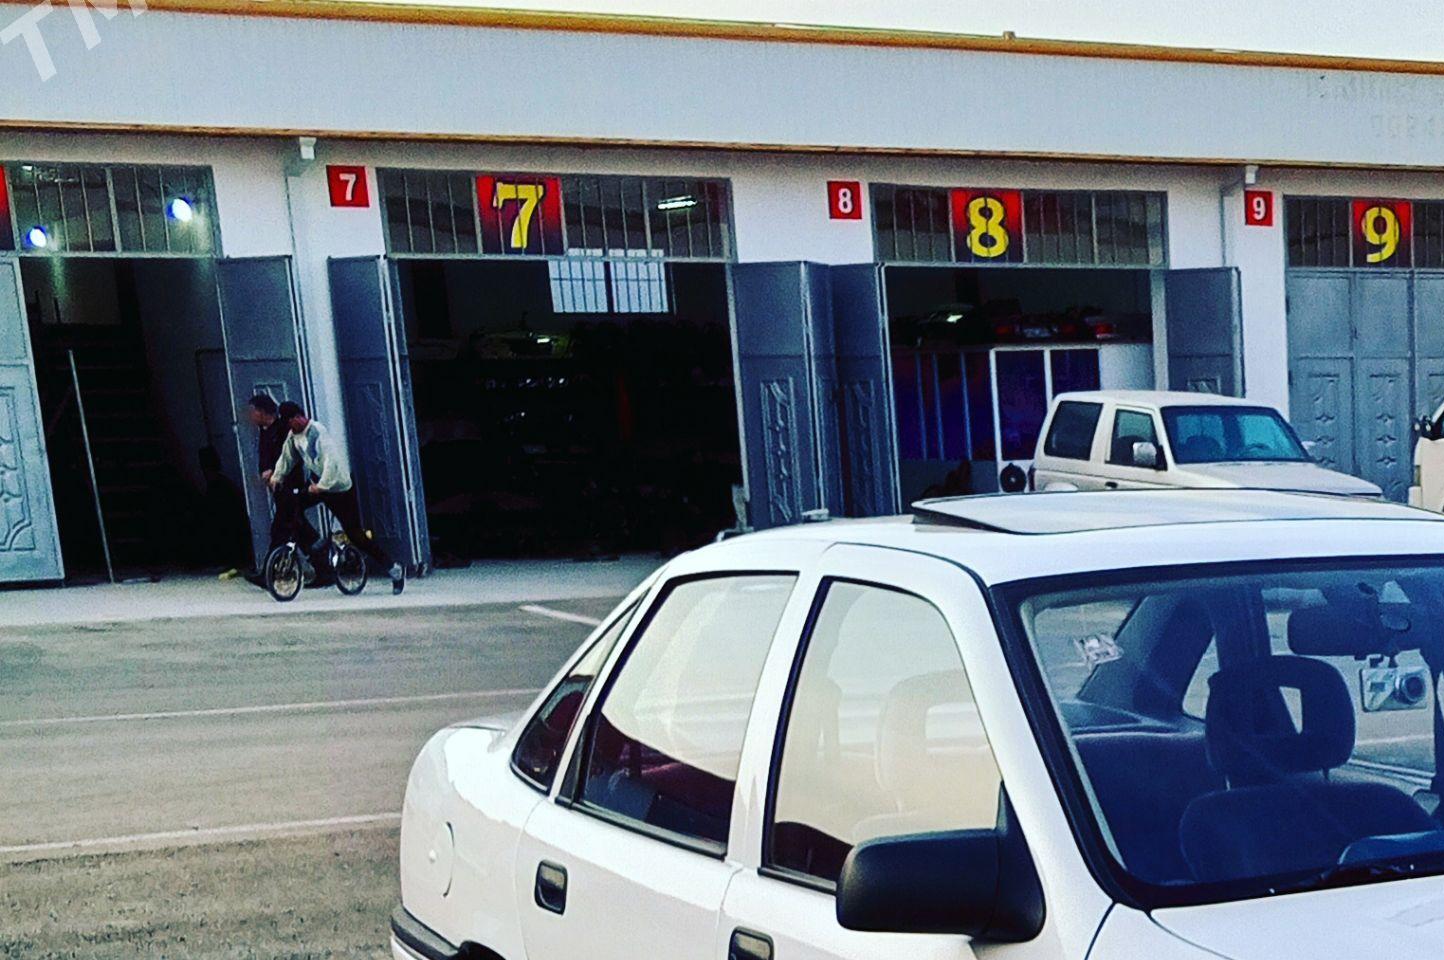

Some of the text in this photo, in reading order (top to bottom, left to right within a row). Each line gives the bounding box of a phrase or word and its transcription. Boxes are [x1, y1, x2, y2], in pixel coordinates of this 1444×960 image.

[339, 173, 357, 200] 7
[838, 188, 853, 214] 8
[493, 181, 544, 249] 7
[967, 197, 1009, 258] 8
[1253, 197, 1267, 221] 9
[1361, 206, 1400, 263] 9
